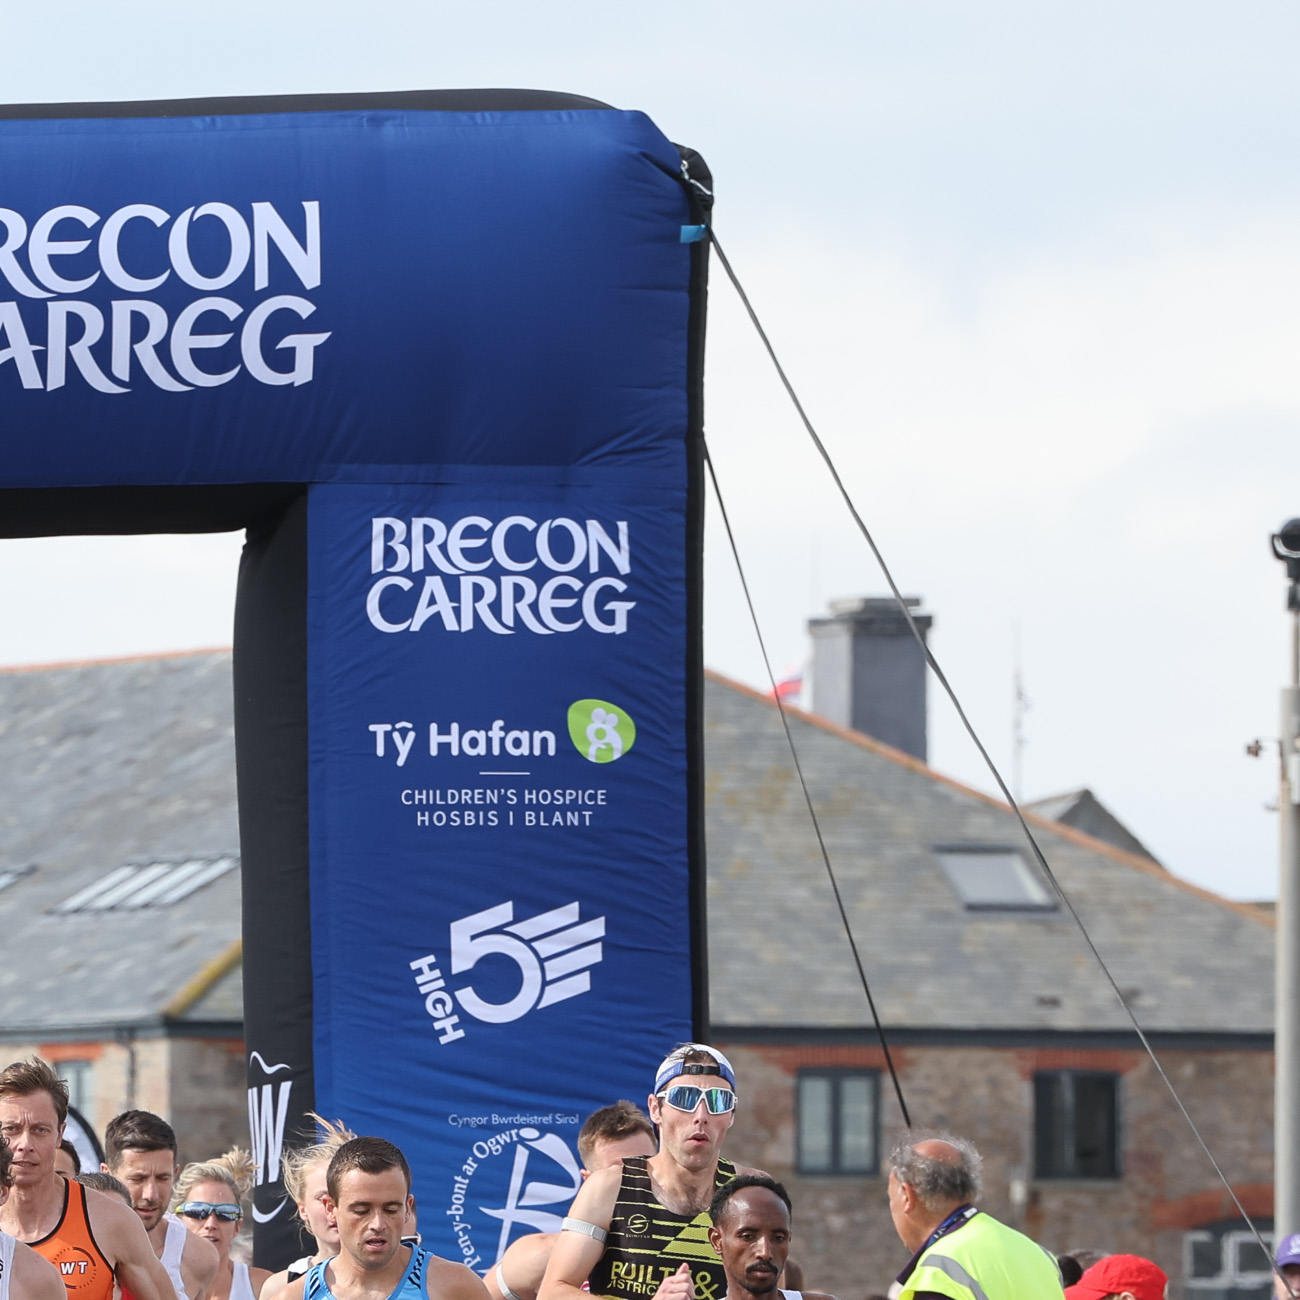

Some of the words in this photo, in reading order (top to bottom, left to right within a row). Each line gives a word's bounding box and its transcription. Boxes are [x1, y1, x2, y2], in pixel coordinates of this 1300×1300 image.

[370, 515, 631, 576] BRECON
[366, 575, 637, 635] CARREG
[368, 720, 416, 767] Tŷ
[429, 720, 556, 757] Hafan
[524, 788, 608, 806] HOSPICE
[416, 811, 499, 827] HOSBIS
[508, 811, 515, 827] I
[525, 811, 594, 828] BLANT
[409, 954, 466, 1046] HIGH
[448, 1114, 488, 1128] Cyngor
[491, 1113, 553, 1125] Bwrdeistref
[555, 1113, 579, 1125] Sirol
[462, 1157, 479, 1176] ar
[472, 1128, 519, 1159] Ogwr
[607, 1279, 658, 1297] ISTRIC
[611, 1261, 676, 1284] BUILT
